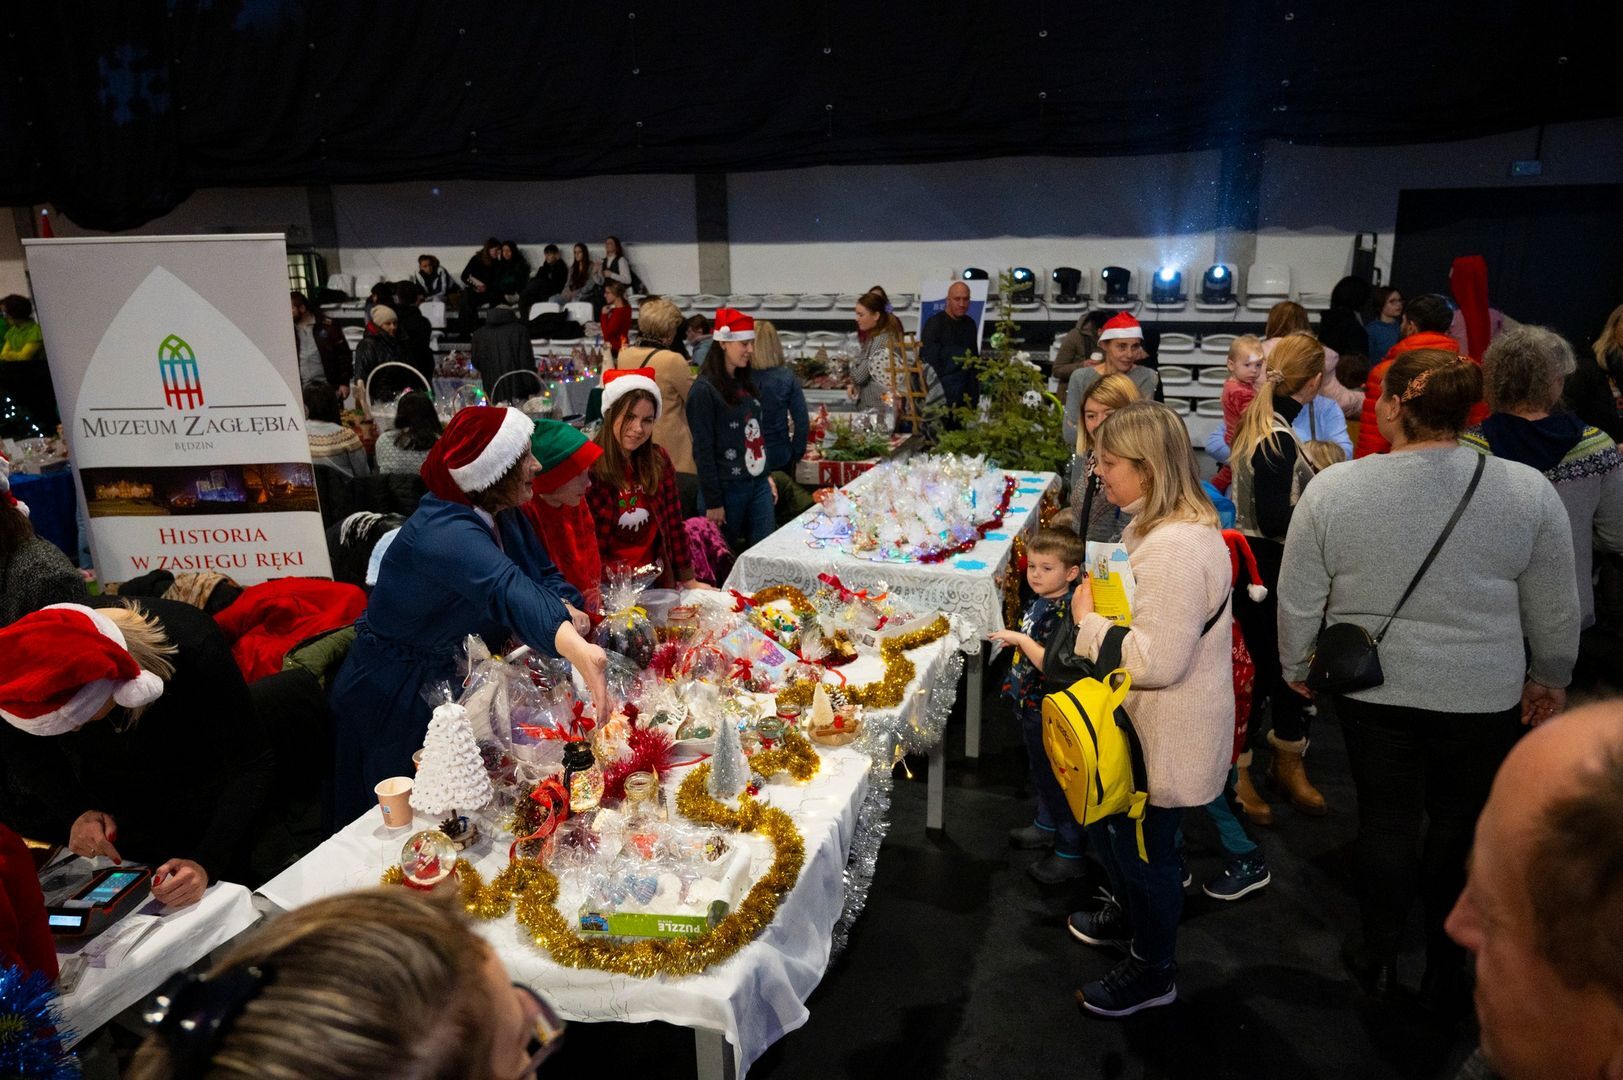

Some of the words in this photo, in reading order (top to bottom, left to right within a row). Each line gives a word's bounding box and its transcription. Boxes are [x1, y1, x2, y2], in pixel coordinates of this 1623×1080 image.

[81, 417, 178, 438] MUZEUM
[184, 415, 300, 436] ZAGŁĘBIA
[174, 441, 214, 452] BĘDZIN
[159, 528, 268, 545] HISTORIA
[131, 555, 150, 570] W
[157, 554, 248, 571] ZASIĘGU
[256, 551, 304, 572] RĘKI
[658, 922, 701, 933] PUZZLE
